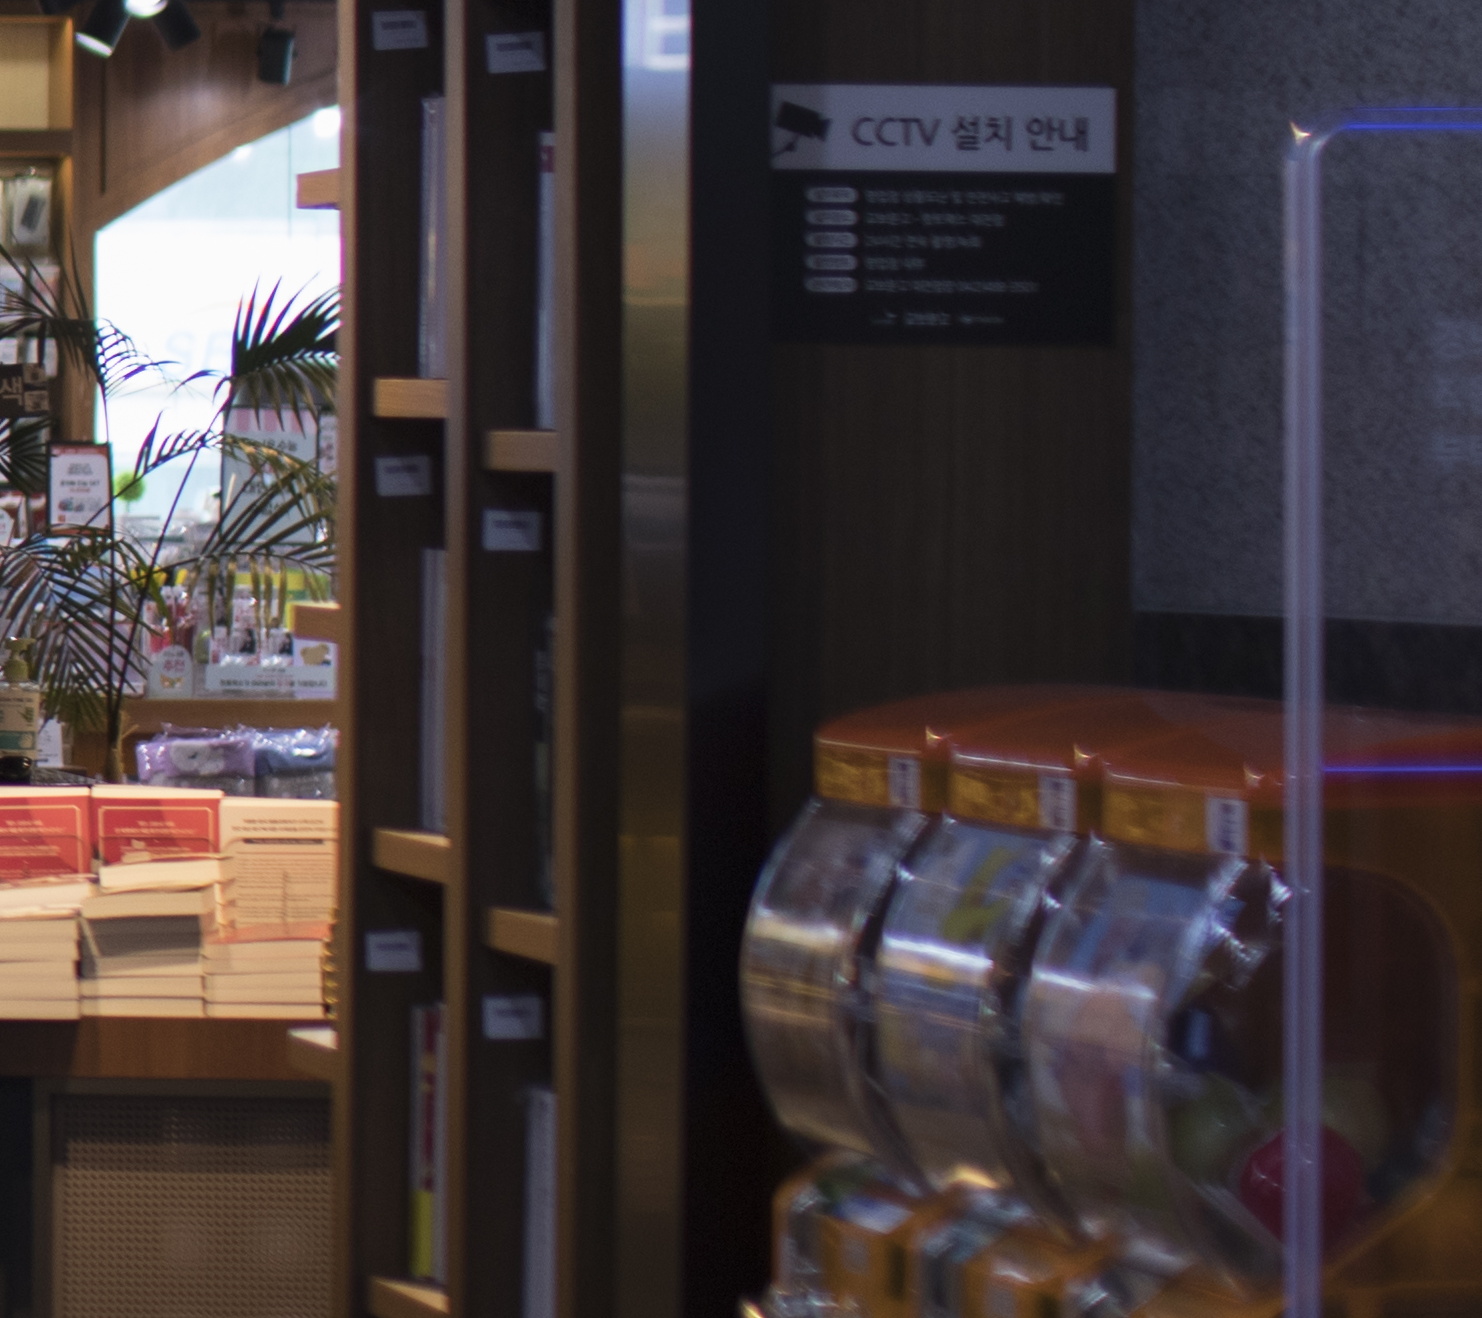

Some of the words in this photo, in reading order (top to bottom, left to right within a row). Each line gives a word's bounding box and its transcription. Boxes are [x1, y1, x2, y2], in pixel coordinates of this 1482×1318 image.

[851, 114, 942, 152] CCTV
[951, 114, 1013, 152] 설치
[1026, 114, 1090, 152] 안내
